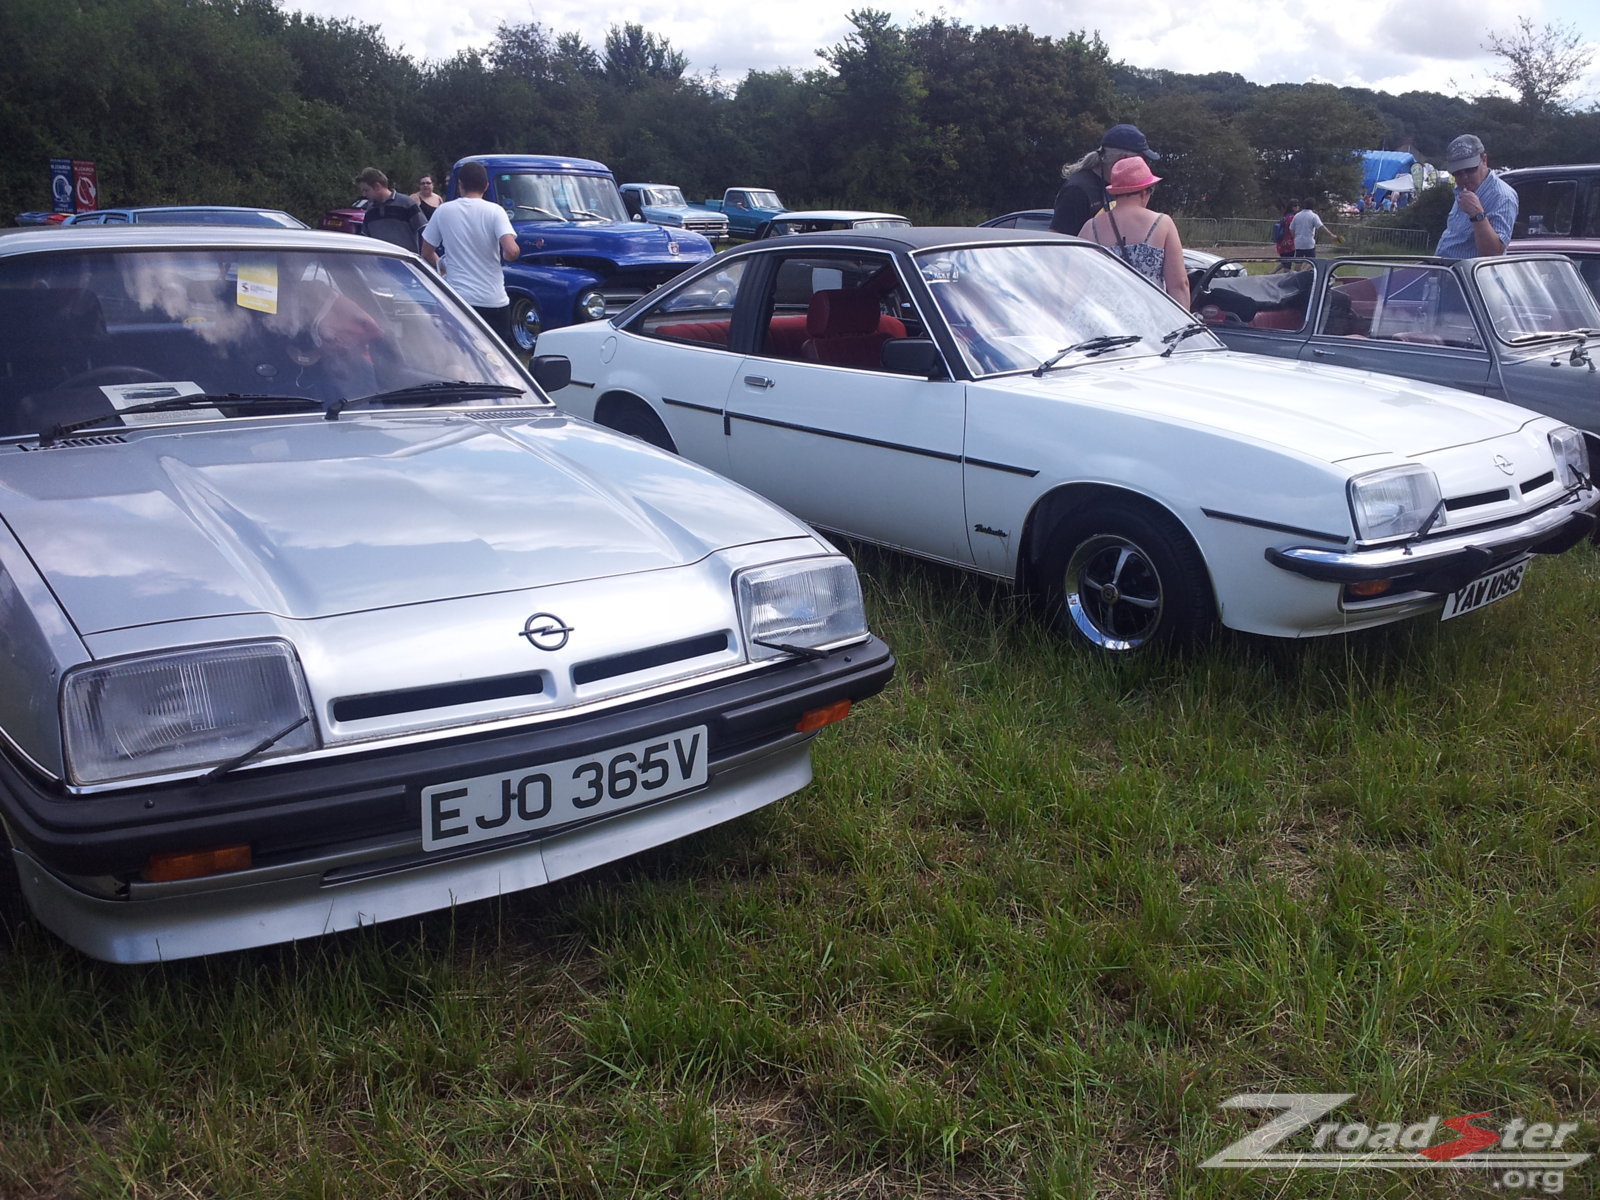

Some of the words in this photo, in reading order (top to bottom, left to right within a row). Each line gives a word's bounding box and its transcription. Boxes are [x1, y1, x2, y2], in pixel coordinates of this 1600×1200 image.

[1486, 565, 1523, 601] 109S
[431, 773, 552, 841] EJO
[572, 734, 700, 809] 365V
